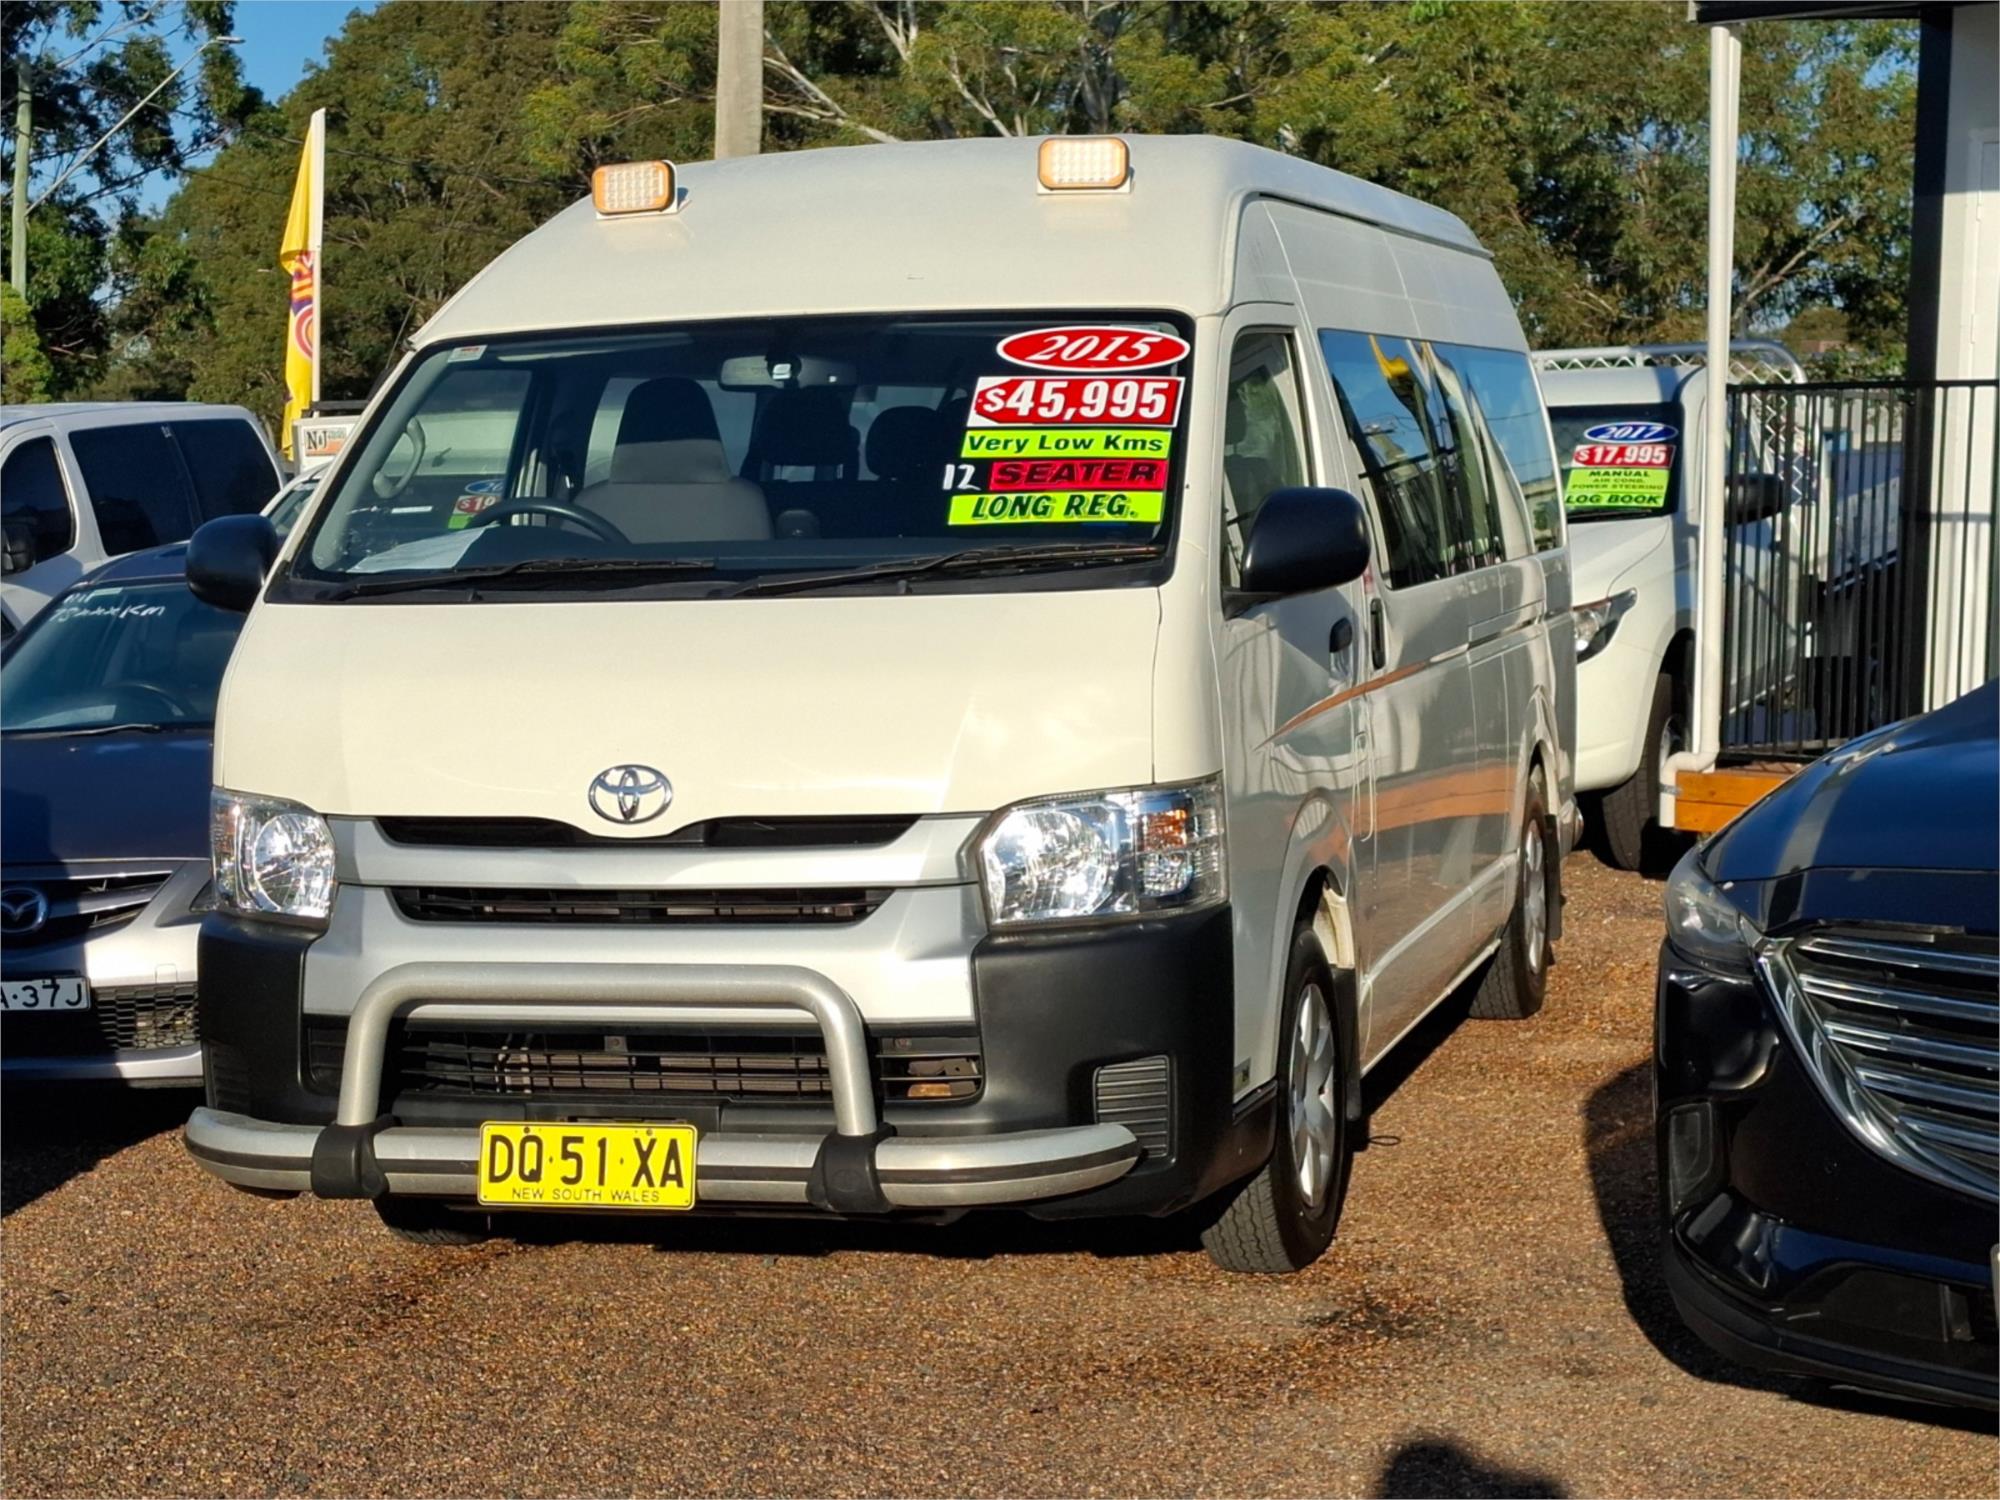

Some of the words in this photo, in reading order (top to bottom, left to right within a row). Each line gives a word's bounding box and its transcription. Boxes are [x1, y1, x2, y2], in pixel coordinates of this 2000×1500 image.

[1024, 334, 1163, 362] 2015
[982, 380, 1169, 421] $45,995
[1597, 426, 1665, 439] 2017
[968, 435, 1030, 454] Very
[1038, 435, 1094, 450] Low
[1104, 435, 1163, 451] Kms
[1578, 445, 1668, 464] $17,995
[942, 463, 982, 491] 12
[993, 461, 1158, 485] SEATER
[971, 494, 1054, 520] LONG
[1063, 494, 1139, 518] REG.
[1566, 494, 1601, 504] LOG
[1607, 494, 1663, 504] BOOK
[512, 1187, 544, 1200] NEW
[552, 1188, 601, 1201] SOUTH
[611, 1190, 660, 1203] WALES
